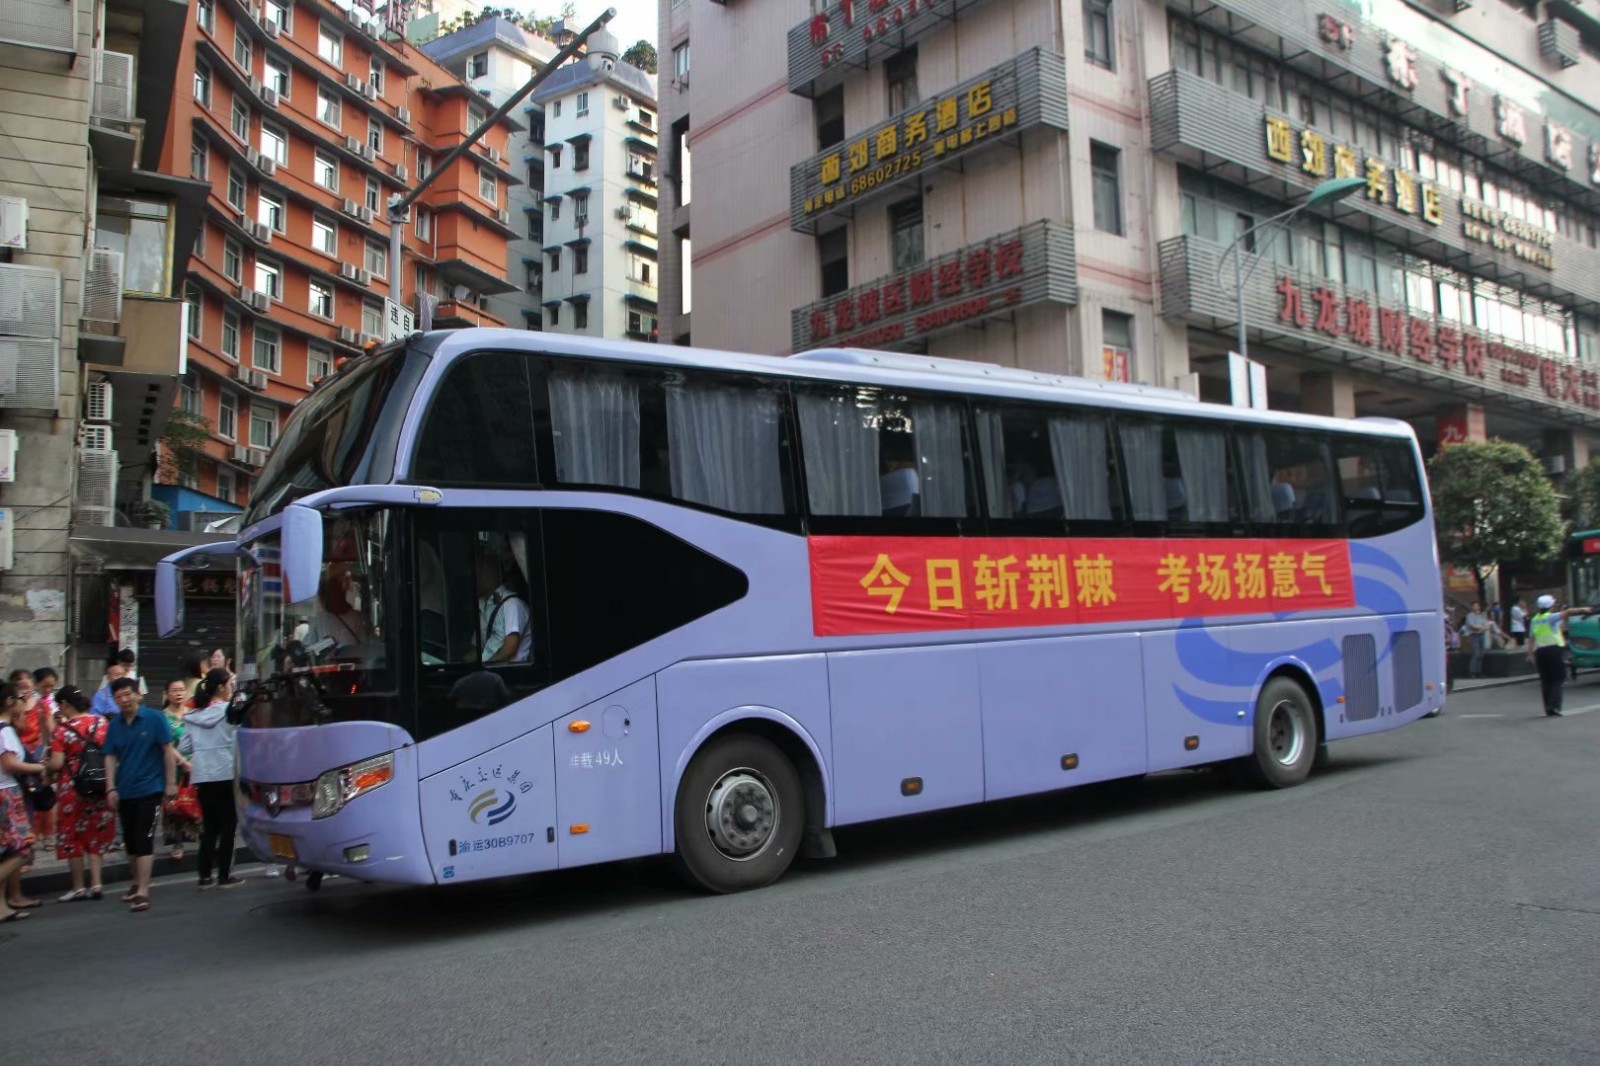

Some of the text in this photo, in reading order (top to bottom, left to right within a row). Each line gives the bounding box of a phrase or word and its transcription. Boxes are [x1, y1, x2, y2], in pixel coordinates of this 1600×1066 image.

[851, 151, 923, 195] 68602725
[860, 551, 1332, 614] 今日斩荆棘 考场扬意气
